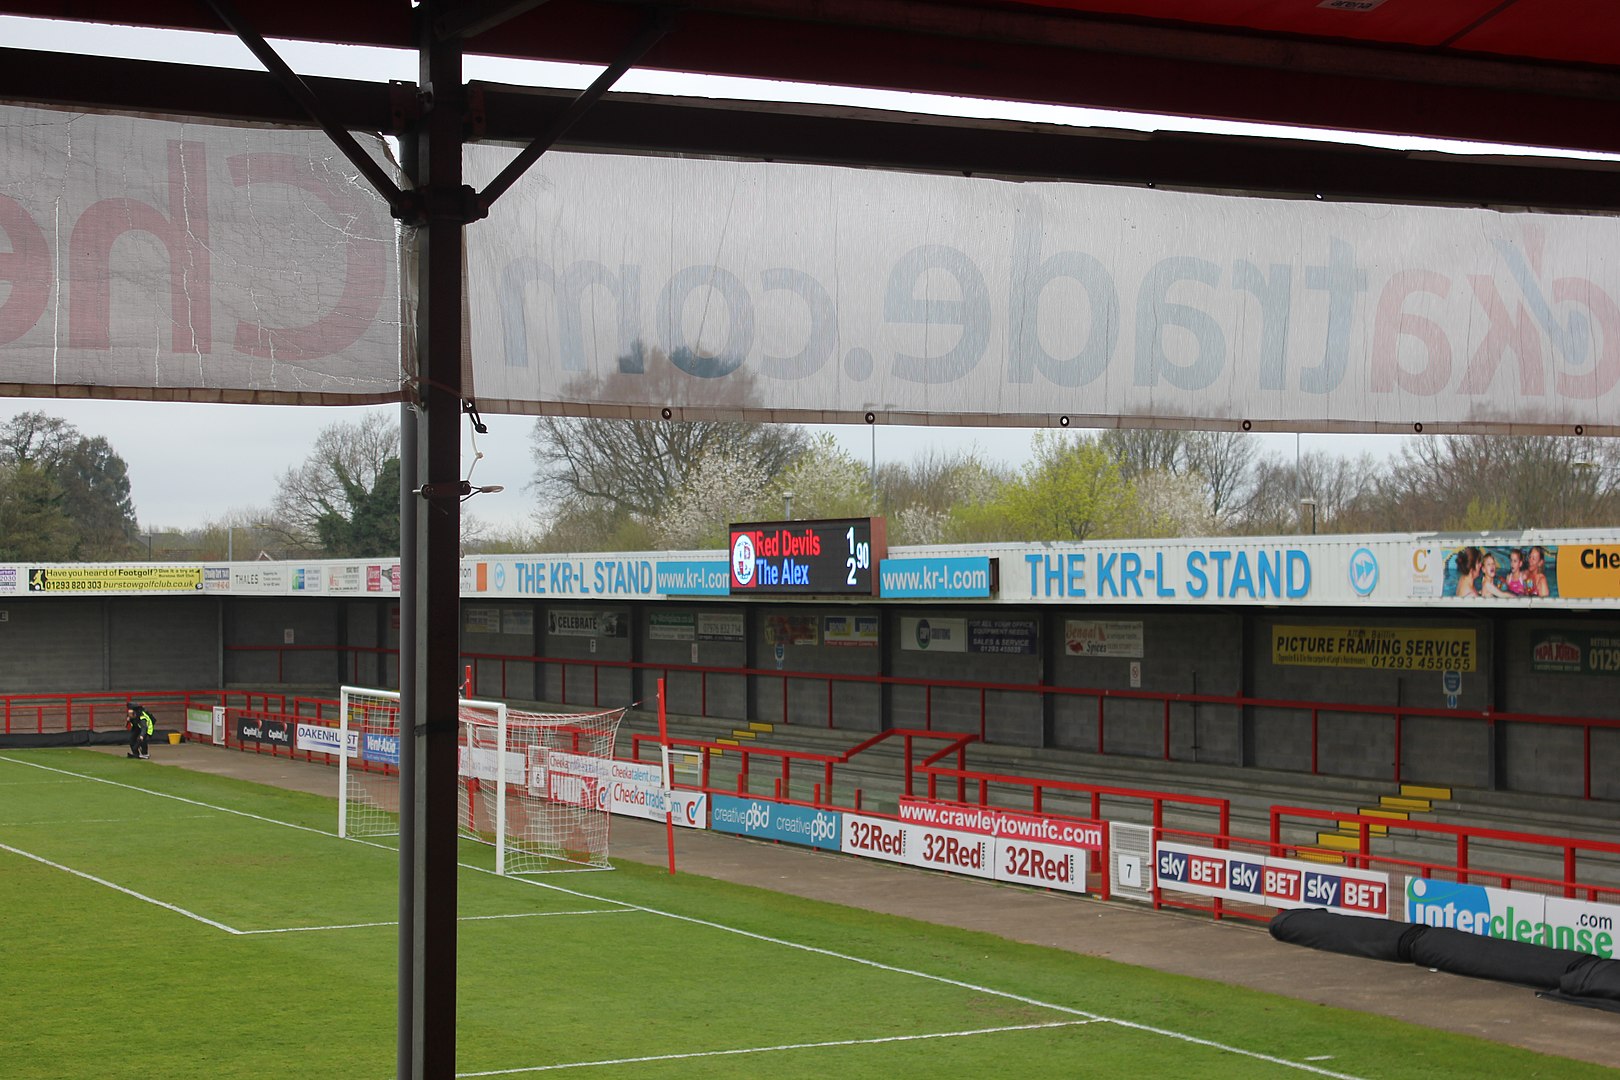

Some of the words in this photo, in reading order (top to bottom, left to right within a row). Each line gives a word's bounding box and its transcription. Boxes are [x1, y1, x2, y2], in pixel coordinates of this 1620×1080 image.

[756, 530, 781, 557] Red
[782, 528, 821, 556] Devils
[846, 527, 855, 555] 1
[856, 542, 870, 570] 90
[46, 569, 67, 577] Have
[68, 570, 83, 578] you
[83, 569, 109, 577] heard
[109, 568, 118, 577] of
[46, 581, 71, 590] 01293
[71, 581, 87, 589] 820
[87, 581, 102, 589] 303
[103, 579, 194, 590] burstowgolfclub.co.uk
[235, 574, 259, 585] THALES
[515, 561, 546, 594] THE
[551, 561, 590, 593] KR-L
[593, 560, 652, 594] STAND
[658, 568, 730, 588] www.kr-l.com
[756, 558, 779, 585] The
[781, 558, 810, 585] Alex
[846, 557, 857, 585] 2
[883, 565, 987, 591] www.kr-l.com
[1025, 553, 1086, 597] THE
[1097, 552, 1175, 598] KR-L
[1186, 550, 1311, 598] STAND
[558, 616, 598, 631] CELEBRATE
[1277, 635, 1334, 653] PICTURE
[1337, 637, 1401, 656] FRAMING
[1405, 639, 1471, 658] SERVICE
[1371, 656, 1414, 669] 01293
[1418, 657, 1471, 670] 455655
[298, 727, 358, 744] OAKENHUST
[613, 782, 682, 814] Checkatrade.om
[850, 821, 902, 856] 32Red
[899, 803, 1102, 846] www.crawleytownfc.com
[922, 833, 982, 869] 32Red
[1005, 845, 1069, 883] 32Red
[1126, 863, 1132, 879] 7
[1160, 852, 1186, 882] sky
[1190, 859, 1224, 884] BET
[1232, 863, 1258, 893] sky
[1265, 871, 1298, 896] BET
[1307, 875, 1338, 906] sky
[1344, 882, 1383, 909] BET
[1575, 913, 1613, 930] .com
